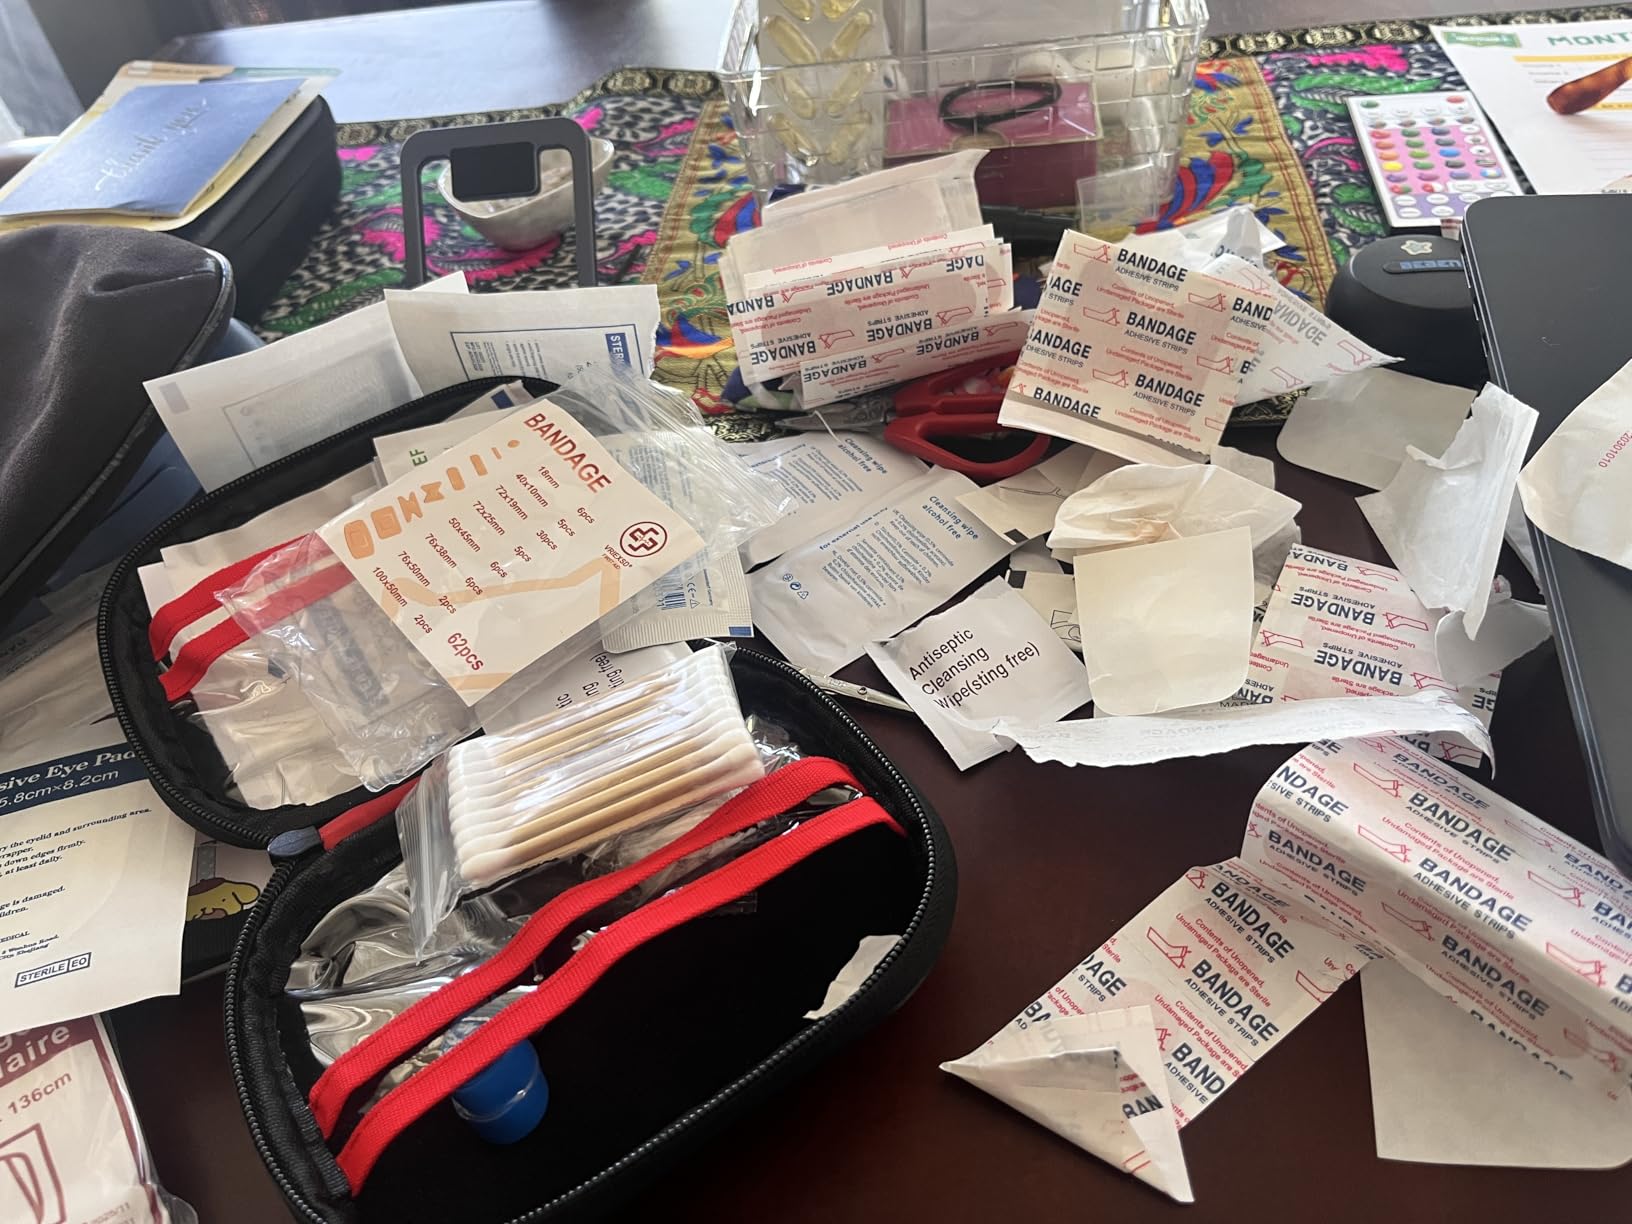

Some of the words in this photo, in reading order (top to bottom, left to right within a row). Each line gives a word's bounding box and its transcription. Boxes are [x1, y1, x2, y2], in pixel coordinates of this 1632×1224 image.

[827, 271, 893, 297] BANDAGE
[1116, 266, 1152, 284] ADHESIVE
[1153, 276, 1179, 292] STRIPS
[1117, 248, 1188, 282] BANDAGE
[894, 310, 928, 320] ADHESIVE
[1048, 292, 1075, 306] STRIPS
[866, 318, 932, 342] BANDAGE
[916, 331, 980, 355] BANDAGE
[1124, 329, 1161, 346] ADHESIVE
[1162, 340, 1189, 356] STRIPS
[1126, 311, 1197, 346] BANDAGE
[750, 341, 817, 365] BANDAGE
[803, 359, 867, 382] BANDAGE
[1058, 354, 1084, 369] STRIPS
[1033, 386, 1101, 419] BANDAGE
[1133, 391, 1170, 408] ADHESIVE
[1170, 402, 1197, 417] STRIPS
[1134, 374, 1205, 407] BANDAGE
[523, 413, 612, 493] BANDAGE
[844, 438, 873, 463] Cleansing
[516, 473, 549, 508] 40x10mm
[557, 518, 576, 538] 5pcs
[538, 465, 560, 489] 18mm
[576, 506, 595, 525] 6pcs
[472, 500, 506, 536] 72x25mm
[514, 545, 532, 563] 5pcs
[495, 484, 528, 521] 72x19mm
[536, 529, 559, 551] 30pcs
[922, 503, 946, 527] alcohol
[946, 523, 962, 540] free
[929, 495, 962, 525] Cleansing
[961, 523, 979, 540] wipe
[424, 532, 458, 569] 76x38mm
[465, 576, 483, 596] 6pcs
[448, 517, 481, 553] 50x45mm
[490, 561, 508, 579] 6pcs
[372, 566, 408, 607] 100x50mm
[414, 614, 433, 634] 2pcs
[397, 550, 431, 587] 76x50mm
[438, 595, 457, 615] 2pcs
[1299, 586, 1330, 598] STRIPS
[1332, 594, 1376, 610] ADHESIVE
[1291, 592, 1376, 626] BANDAGE
[1322, 641, 1354, 655] STRIPS
[1339, 623, 1372, 638] Package
[1372, 630, 1416, 649] Undamaged
[447, 632, 484, 671] 62pcs
[589, 652, 614, 673] free)
[909, 629, 974, 681] Antiseptic
[921, 647, 990, 695] Cleansing
[1314, 649, 1402, 686] BANDAGE
[1357, 651, 1402, 668] ADHESIVE
[933, 664, 1009, 709] Wipe(sting
[1005, 641, 1040, 668] free)
[45, 760, 89, 780] Eye
[1393, 753, 1490, 810] BANDAGE
[1277, 766, 1349, 815] NDAGE
[10, 840, 24, 850] the
[25, 832, 52, 846] eyelid
[54, 826, 71, 838] and
[72, 812, 128, 833] surrounding
[129, 808, 152, 817] area.
[1295, 798, 1331, 823] STRIPS
[1408, 792, 1515, 861] BANDAGE
[4, 855, 29, 867] down
[30, 848, 55, 860] edges
[57, 839, 86, 853] firmly.
[1404, 821, 1442, 849] Contents
[1453, 851, 1500, 883] Unopened,
[1405, 806, 1458, 838] ADHESIVE
[1462, 838, 1501, 865] STRIPS
[5, 867, 15, 875] at
[16, 861, 37, 873] least
[38, 854, 62, 868] daily.
[1268, 829, 1367, 894] BANDAGE
[1269, 845, 1318, 873] ADHESIVE
[1382, 816, 1432, 852] Undamaged
[1431, 849, 1467, 874] Package
[1485, 879, 1514, 900] Sterile
[12, 899, 20, 907] is
[22, 885, 66, 904] damaged.
[1413, 872, 1471, 912] ADHESIVE
[1473, 909, 1515, 940] STRIPS
[1418, 857, 1533, 932] BANDAGE
[1205, 897, 1245, 934] ADHESIVE
[1245, 935, 1276, 963] STRIPS
[1211, 882, 1295, 959] BANDAGE
[19, 963, 66, 983] STERILE
[71, 957, 87, 968] EO
[1103, 943, 1121, 964] Sterile
[1175, 912, 1213, 952] Undamaged
[1212, 947, 1239, 977] Package
[1238, 974, 1251, 988] are
[1249, 984, 1271, 1008] Sterile
[1195, 918, 1224, 946] Contents
[1223, 944, 1233, 956] of
[1230, 950, 1265, 988] Unopened,
[1078, 974, 1106, 1002] STRIPS
[1441, 950, 1495, 988] ADHESIVE
[1499, 990, 1537, 1021] STRIPS
[1442, 935, 1550, 1016] BANDAGE
[1175, 1000, 1205, 1030] Contents
[1204, 1027, 1215, 1039] of
[1184, 978, 1227, 1017] ADHESIVE
[1227, 1017, 1259, 1047] STRIPS
[1191, 959, 1280, 1041] BANDAGE
[1154, 994, 1194, 1033] Undamaged
[1193, 1031, 1221, 1061] Package
[1221, 1058, 1233, 1073] are
[1164, 1061, 1209, 1104] ADHESIVE
[1171, 1042, 1226, 1095] BAND
[7, 1072, 72, 1115] 136cm
